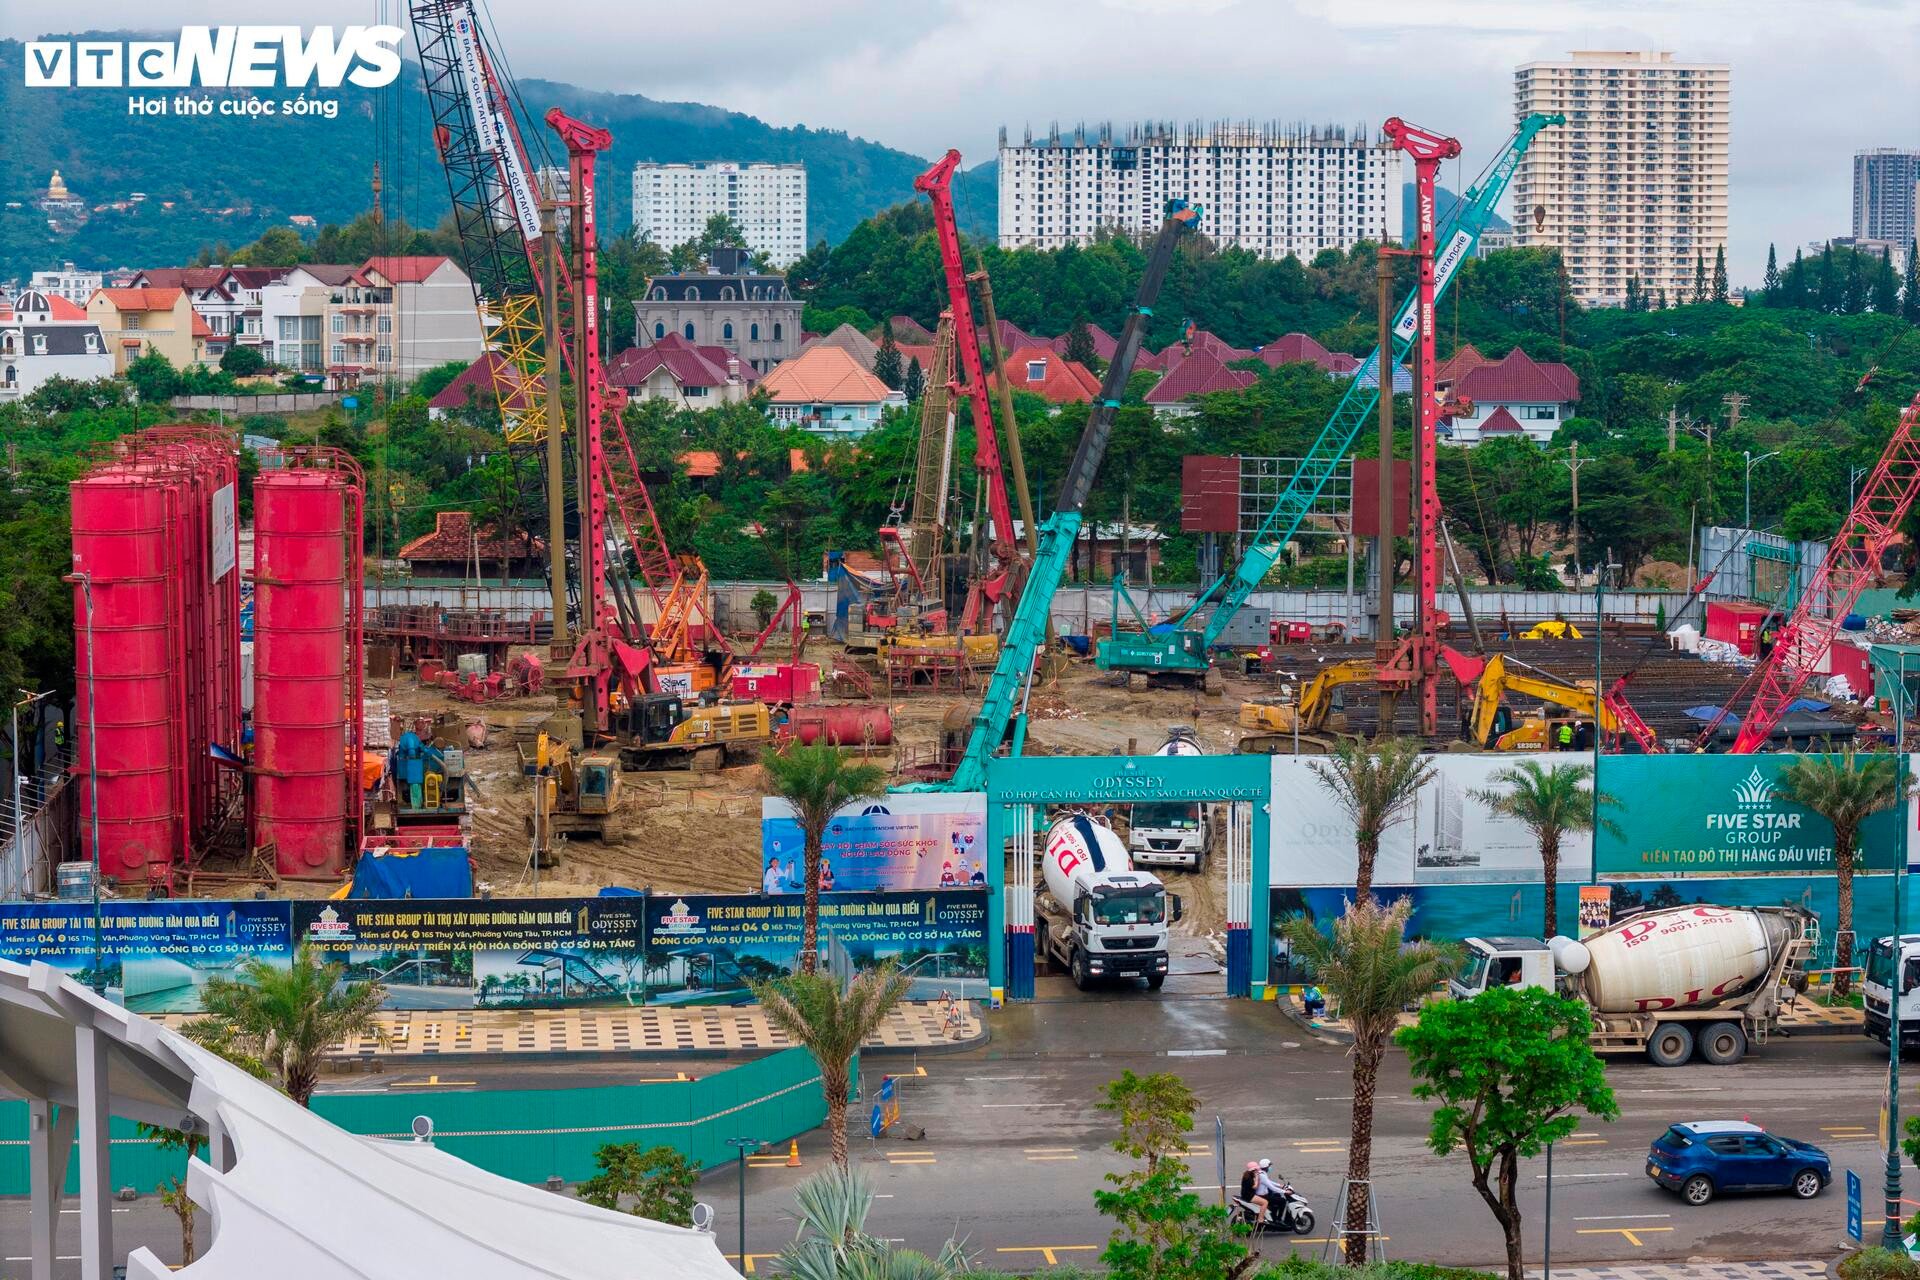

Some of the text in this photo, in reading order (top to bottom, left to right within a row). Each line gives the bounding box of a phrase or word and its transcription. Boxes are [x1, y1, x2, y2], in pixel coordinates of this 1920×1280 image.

[462, 38, 476, 74] BACHY
[583, 185, 593, 224] SANY
[1421, 194, 1432, 233] SANY
[1094, 776, 1165, 789] ODYSSEY
[1157, 788, 1177, 798] SAO
[1706, 813, 1801, 830] FIVE STAR
[1726, 831, 1782, 843] GROUP
[1077, 848, 1089, 861] ISO
[1642, 846, 1670, 863] KIẾN
[1673, 850, 1695, 866] TẠO
[1698, 847, 1715, 863] ĐÔ
[1719, 850, 1738, 866] THỊ
[1742, 847, 1776, 863] HÀNG
[1778, 845, 1803, 862] ĐẦU
[1806, 846, 1832, 865] VIỆT
[707, 907, 723, 919] FIVE
[725, 907, 745, 919] STAR
[746, 906, 771, 918] GROUP
[772, 903, 785, 918] TÀI
[787, 905, 801, 919] TRỢ
[885, 903, 901, 916] QUA
[902, 900, 920, 915] BIỂN
[939, 910, 985, 920] ODYSSEY
[2, 918, 19, 930] FIVE
[20, 918, 40, 930] STAR
[42, 917, 68, 929] GROUP
[184, 915, 200, 928] QUA
[357, 914, 373, 926] FIVE
[375, 914, 395, 926] STAR
[396, 914, 421, 926] GROUP
[423, 911, 435, 925] TÀI
[437, 913, 452, 927] TRỢ
[453, 912, 471, 925] XÂY
[537, 912, 553, 925] QUA
[554, 908, 572, 924] BIỂN
[592, 919, 638, 929] ODYSSEY
[240, 922, 287, 933] ODYSSEY
[742, 922, 758, 932] 04
[1626, 935, 1649, 948] ISO
[1702, 917, 1733, 925] 2015
[37, 933, 55, 944] 04
[392, 930, 408, 940] 04
[502, 930, 523, 940] Vũng
[651, 935, 680, 945] ĐÓNG
[683, 936, 704, 945] GÓP
[706, 935, 727, 944] VÀO
[729, 935, 742, 945] SỰ
[744, 934, 770, 944] PHÁT
[861, 931, 890, 941] ĐỒNG
[892, 931, 906, 941] BỘ
[908, 931, 922, 940] CƠ
[924, 929, 938, 939] SỞ
[940, 931, 953, 940] HẠ
[956, 929, 982, 938] TẦNG
[1, 946, 23, 955] VÀO
[332, 941, 354, 951] GÓP
[356, 942, 377, 951] VÀO
[379, 941, 393, 952] SỰ
[394, 941, 421, 951] PHÁT
[453, 941, 467, 950] XÃ
[469, 941, 486, 951] HỘI
[489, 940, 511, 950] HÓA
[512, 940, 542, 950] ĐỒNG
[544, 940, 558, 950] BỘ
[560, 940, 575, 949] CƠ
[577, 939, 591, 948] SỞ
[592, 940, 607, 949] HẠ
[1635, 975, 1745, 1011] DIC
[1851, 1176, 1857, 1194] P
